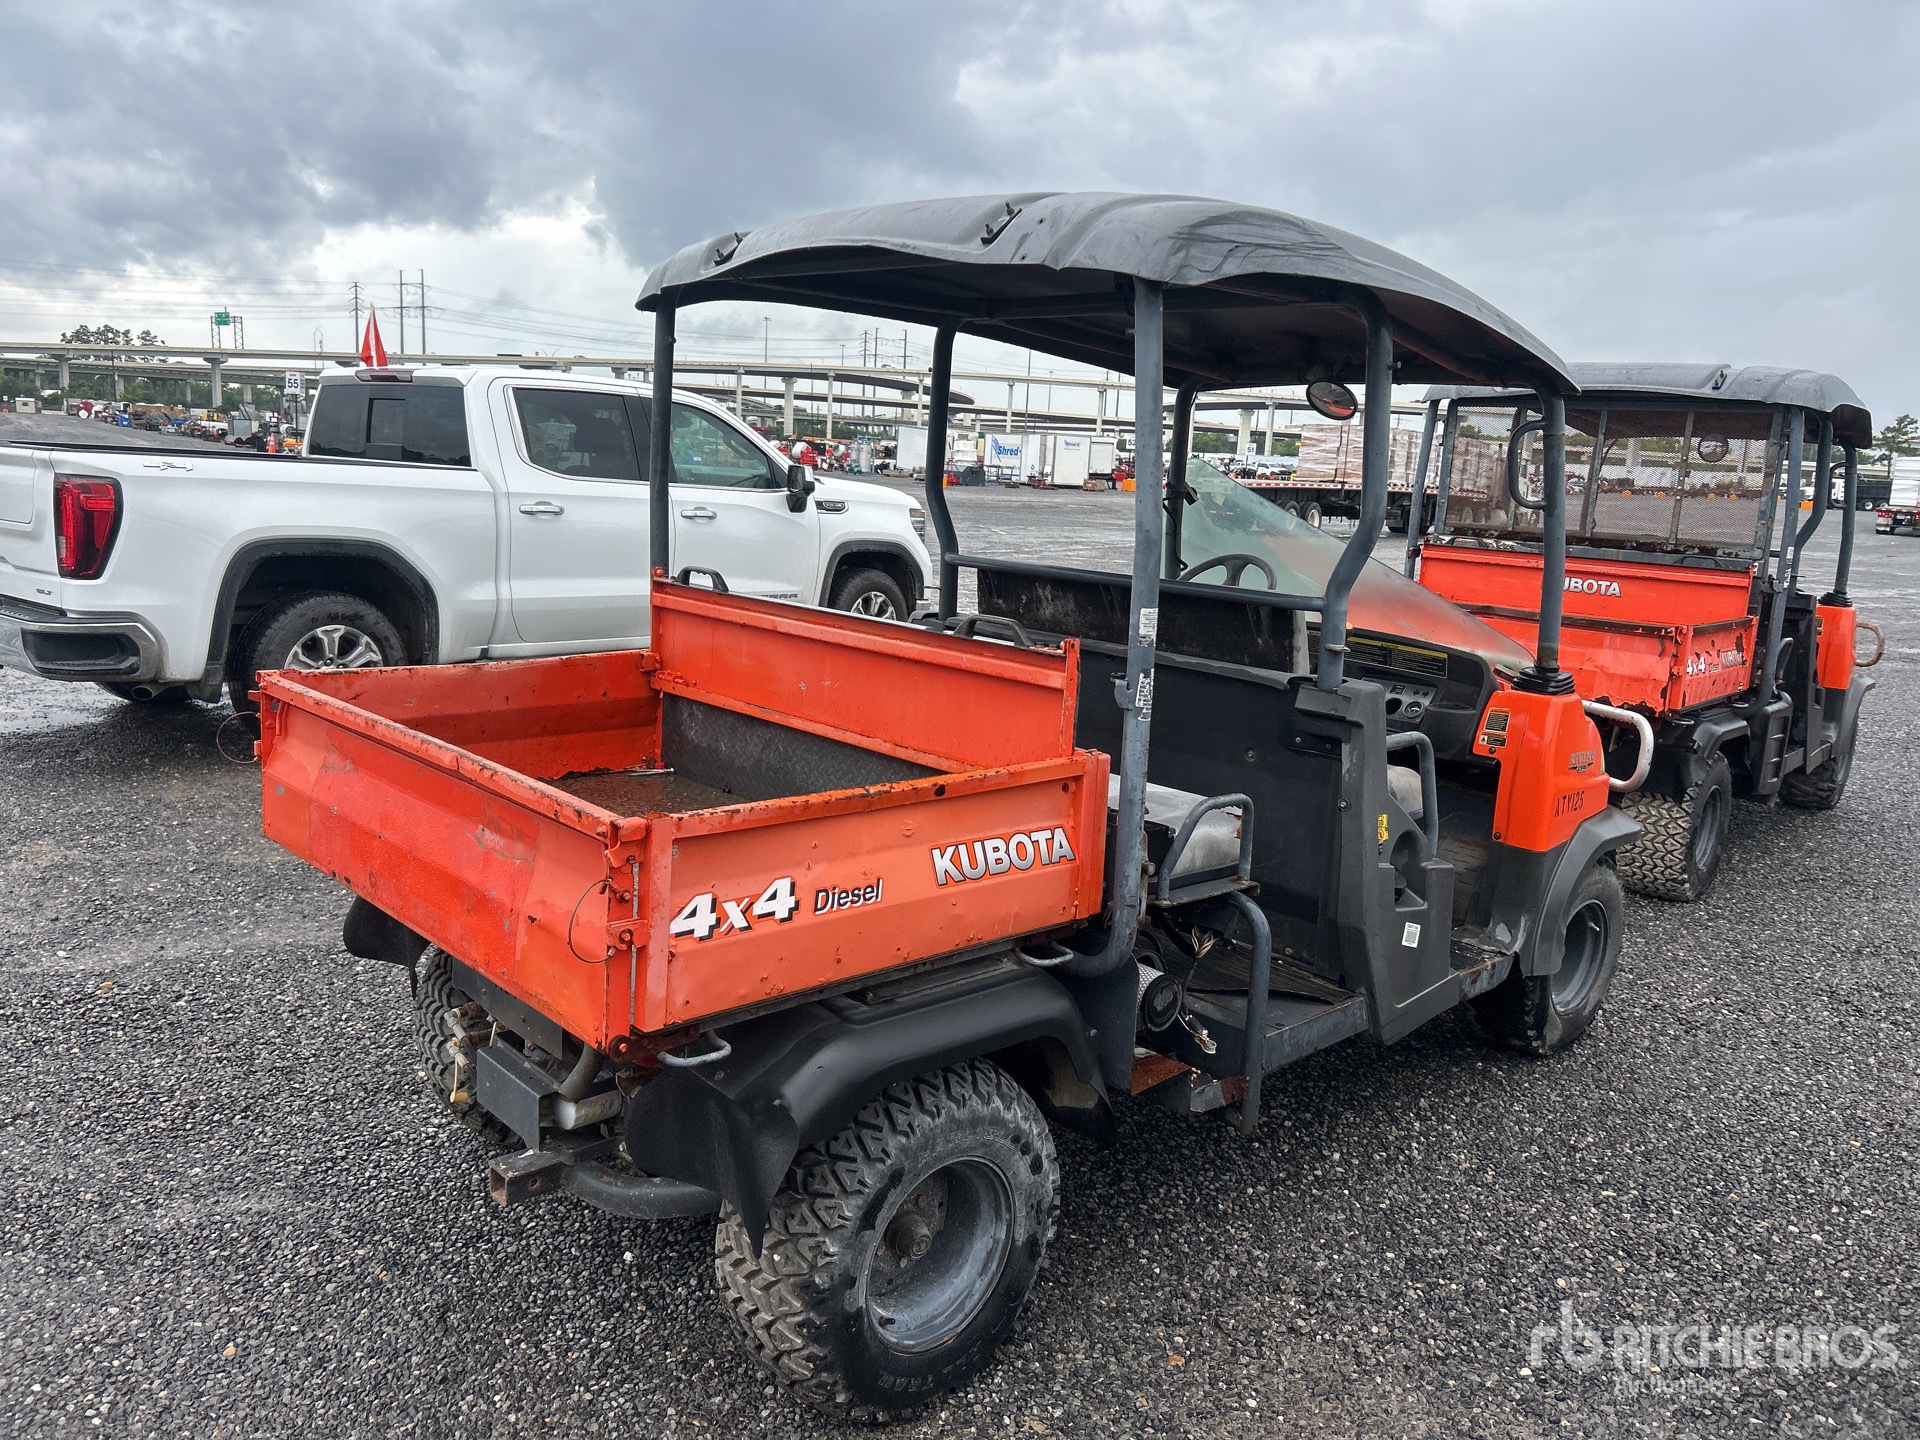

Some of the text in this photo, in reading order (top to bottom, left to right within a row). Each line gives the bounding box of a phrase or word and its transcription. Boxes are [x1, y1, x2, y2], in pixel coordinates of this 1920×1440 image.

[287, 378, 299, 389] 55
[669, 827, 1076, 942] 4x4 Diesel KUBOTA
